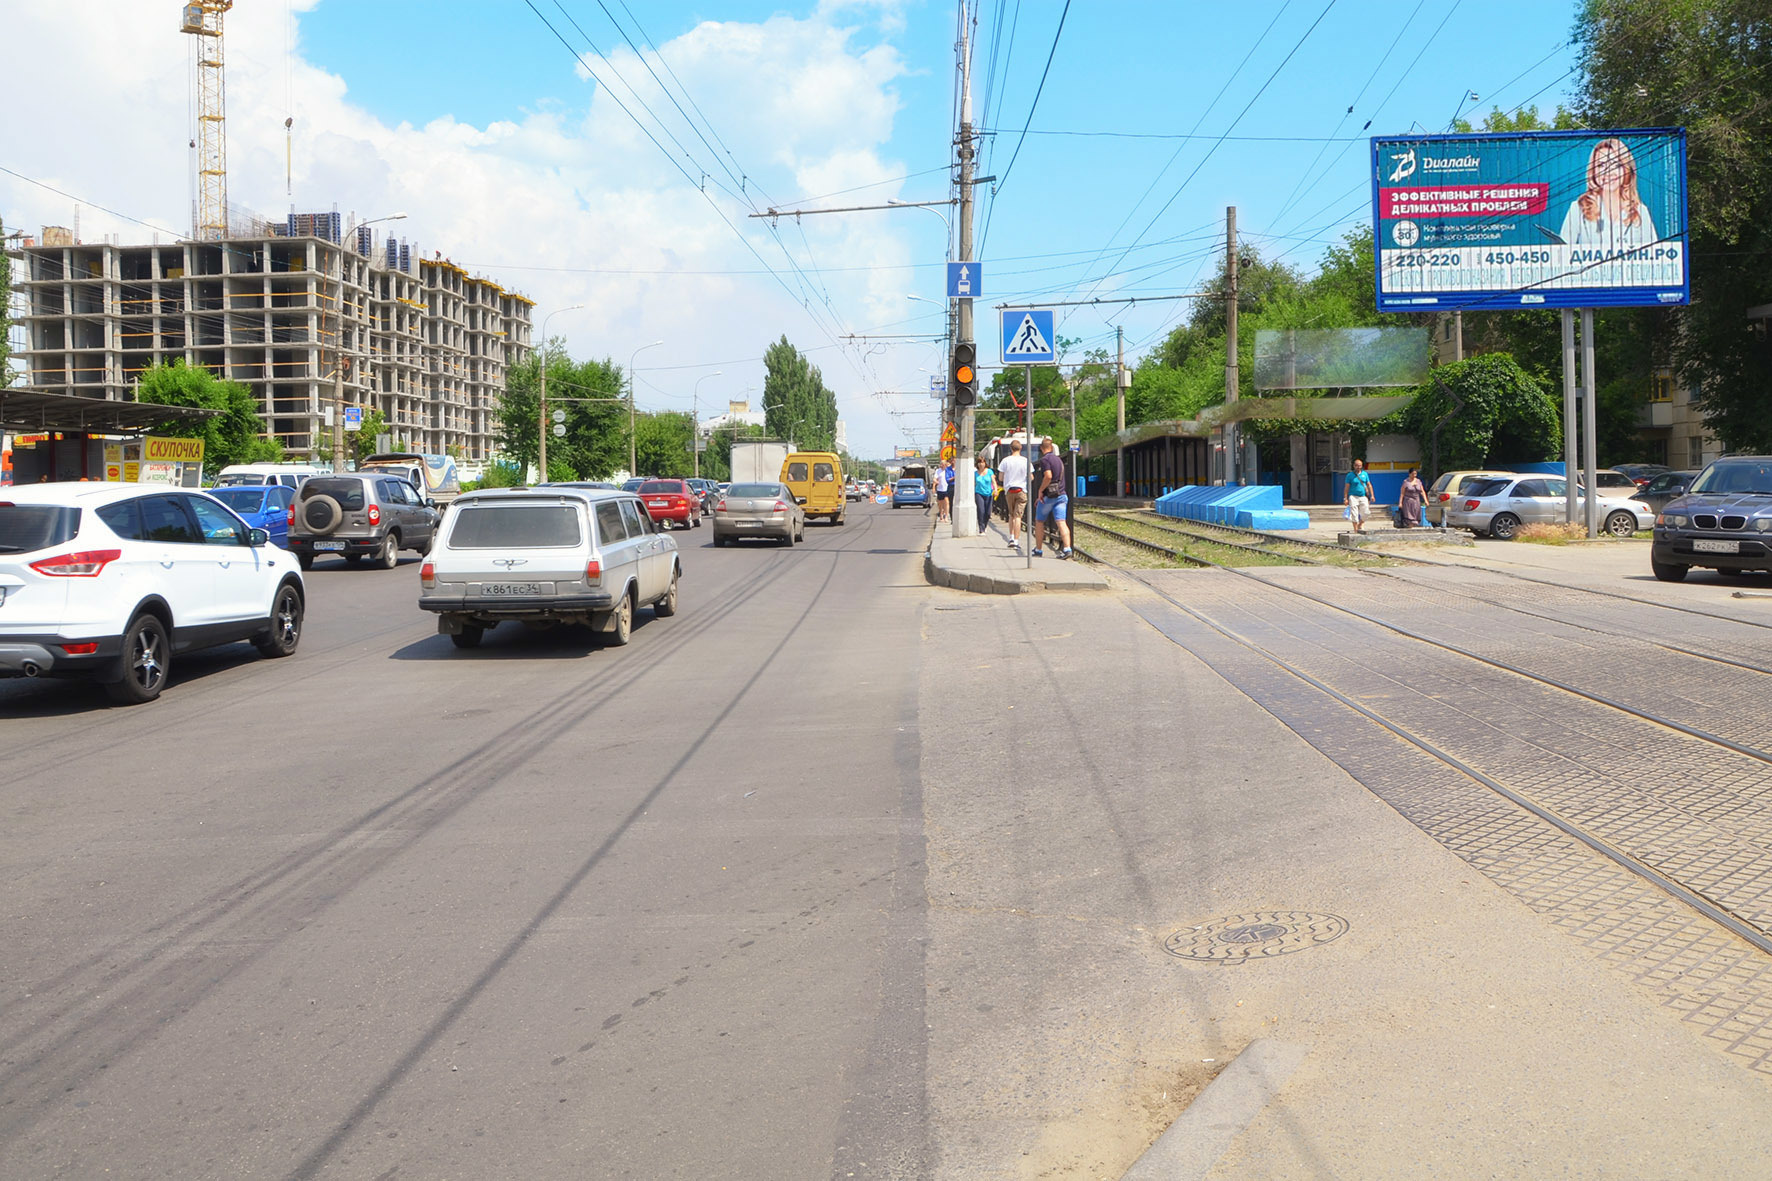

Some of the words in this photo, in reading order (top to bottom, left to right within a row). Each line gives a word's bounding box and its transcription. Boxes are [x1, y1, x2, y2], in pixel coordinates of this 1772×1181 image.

[1423, 155, 1479, 169] Диалайн
[1391, 190, 1480, 201] ЭФФЕКТИВНЫЕ
[1483, 188, 1539, 200] РЕШЕНИЯ
[1391, 202, 1469, 215] ДЕЛИКАТНЫХ
[1471, 200, 1528, 212] ПРОБЛЕМ
[1396, 253, 1460, 267] 220-220
[1485, 251, 1549, 264] 450-450
[1570, 245, 1678, 264] ДИАЛАЙН.РФ
[150, 441, 200, 458] СКУПОЧКА
